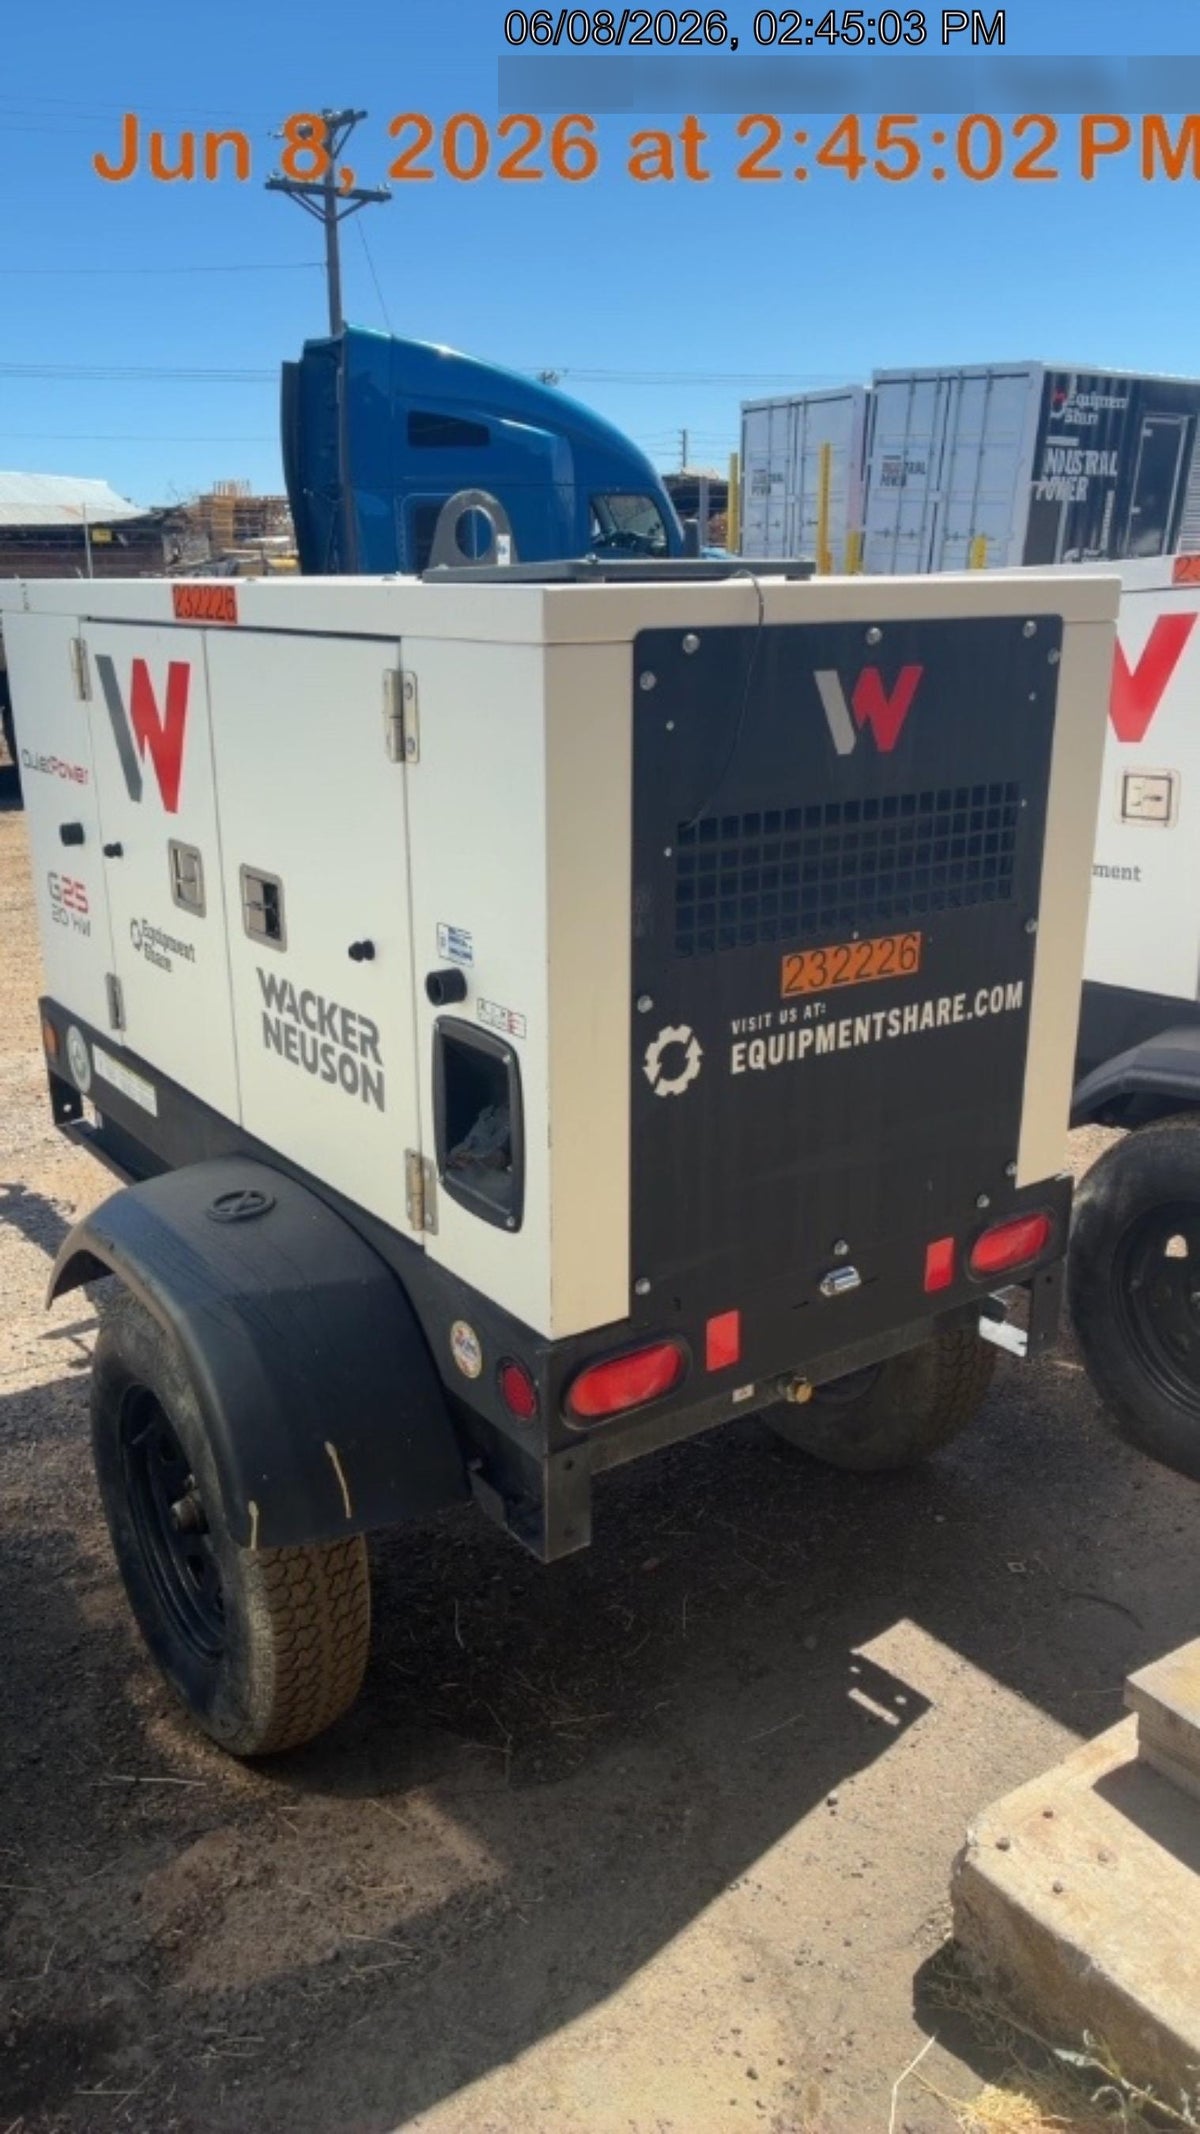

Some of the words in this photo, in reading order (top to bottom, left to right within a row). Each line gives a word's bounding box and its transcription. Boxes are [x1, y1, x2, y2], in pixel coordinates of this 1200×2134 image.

[48, 872, 89, 914] G25
[142, 919, 195, 963] Equipment
[784, 934, 917, 994] 232226
[256, 967, 383, 1066] WACKER
[731, 1013, 771, 1035] VISIT
[779, 1007, 797, 1025] US
[803, 1002, 826, 1020] AT:
[731, 981, 1024, 1075] EQUIPMENTSHARE.COM
[262, 1011, 385, 1112] NEUSON
